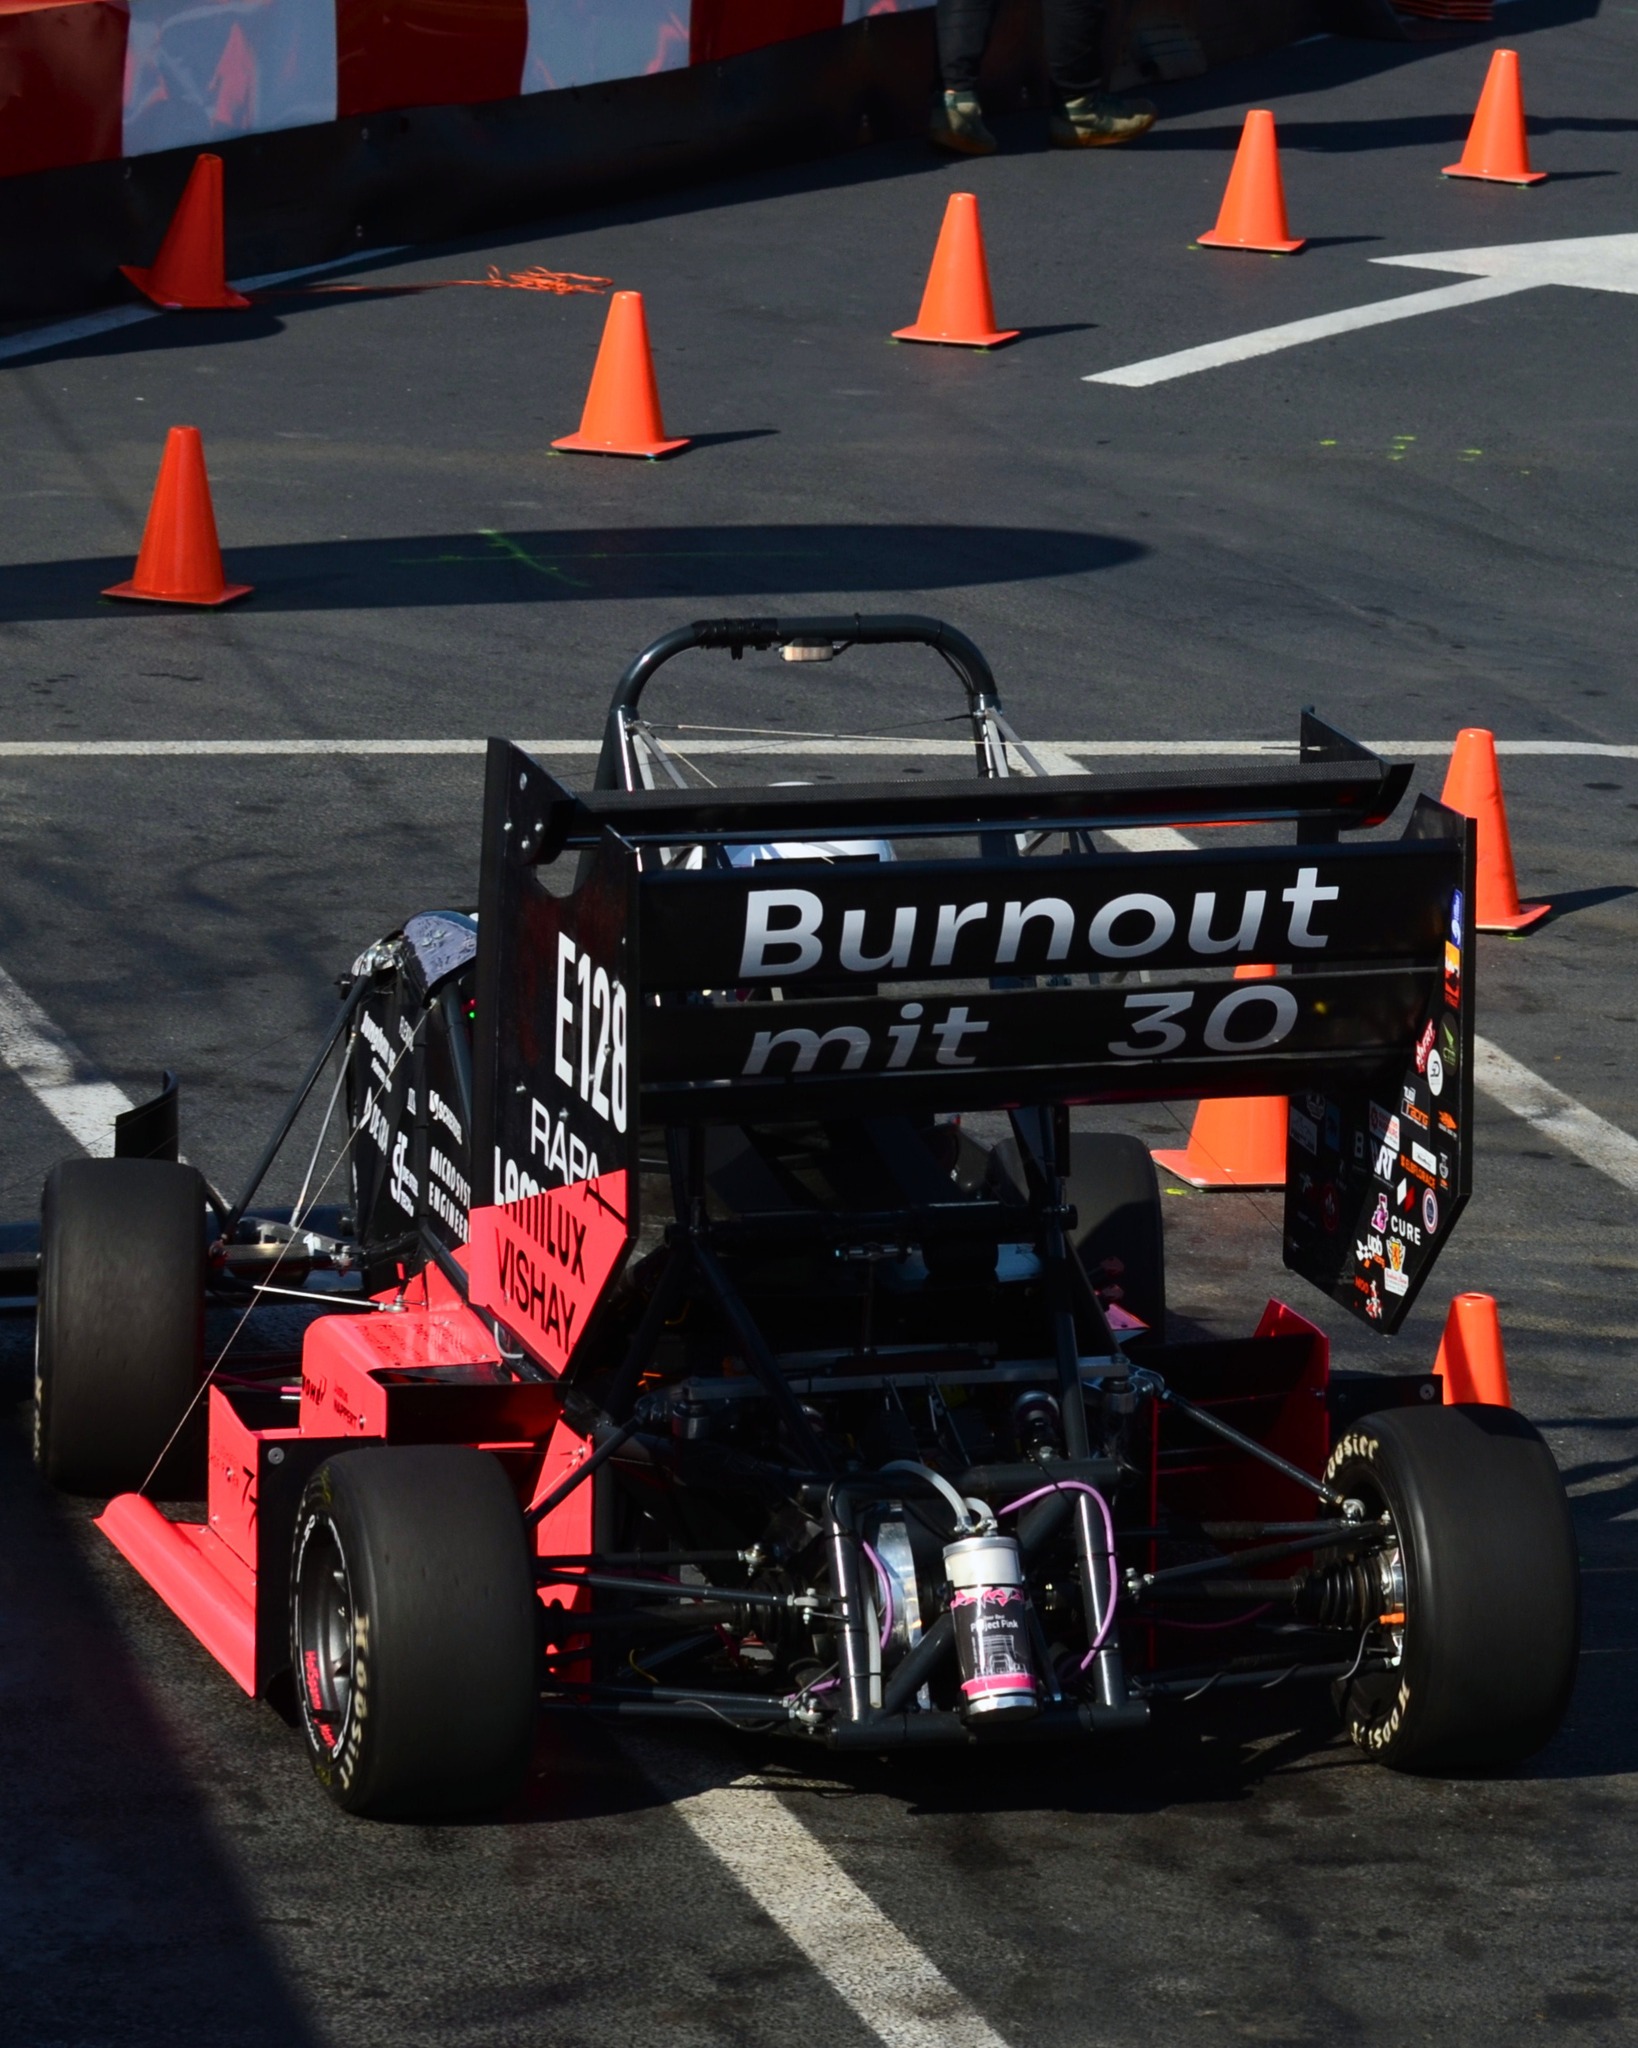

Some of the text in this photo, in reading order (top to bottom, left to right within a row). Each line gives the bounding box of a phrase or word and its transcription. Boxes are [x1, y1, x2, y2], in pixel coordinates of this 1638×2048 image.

[738, 867, 1340, 979] Burnout
[554, 930, 627, 1134] E128
[740, 984, 1299, 1076] mit 30
[1390, 1214, 1421, 1246] CURE
[496, 1226, 577, 1355] VISHAY
[970, 1618, 1019, 1632] Pject Pink
